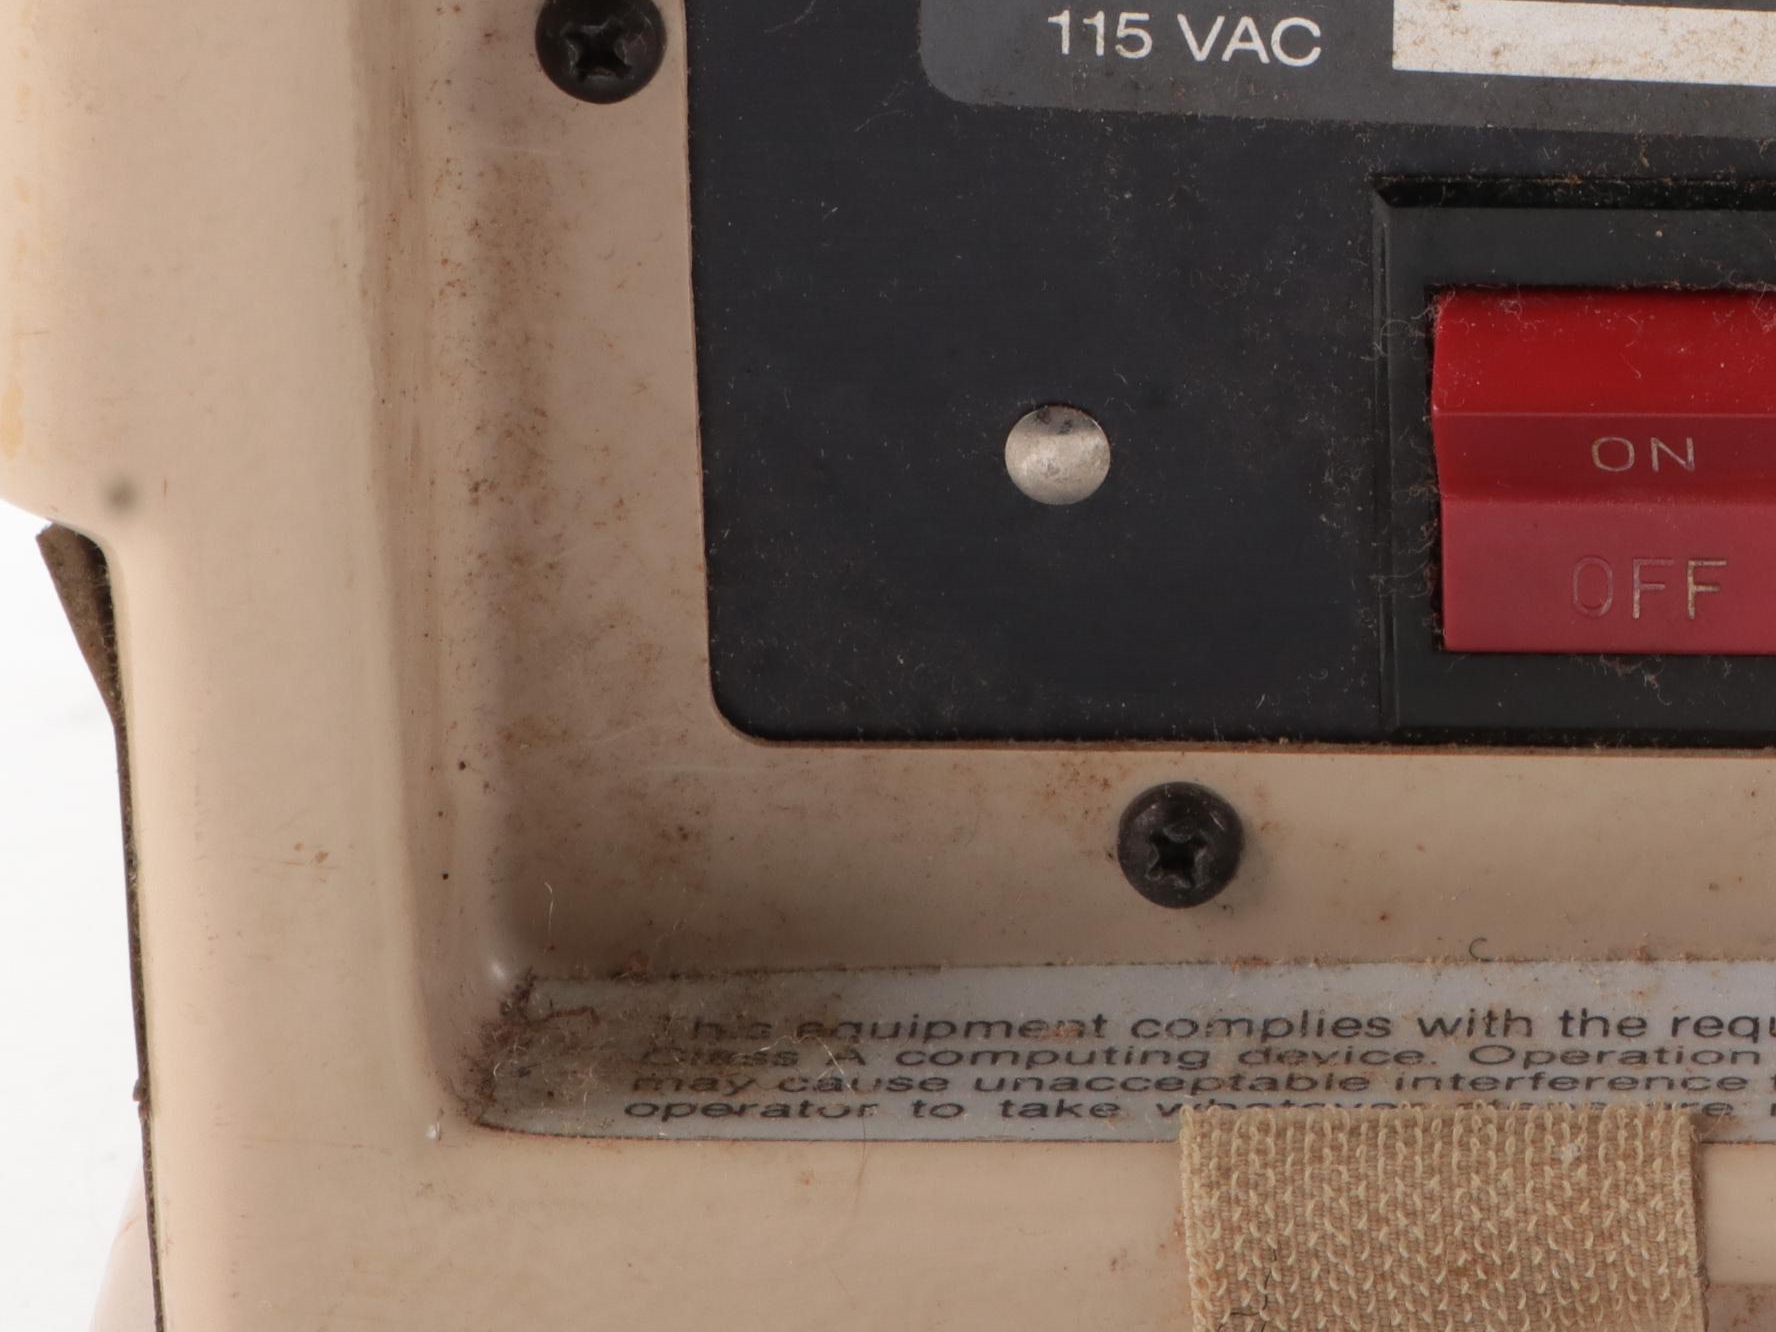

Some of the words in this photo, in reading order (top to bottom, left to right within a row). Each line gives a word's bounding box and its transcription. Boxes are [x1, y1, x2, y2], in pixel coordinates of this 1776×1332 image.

[1047, 8, 1154, 60] 115
[1176, 13, 1324, 68] VAC
[1590, 436, 1698, 473] ON
[1571, 555, 1728, 620] OFF
[796, 1013, 1109, 1045] equipment
[1130, 1009, 1392, 1044] complies
[1417, 1007, 1533, 1039] with
[1559, 1007, 1648, 1039] the
[825, 1048, 867, 1067] A
[894, 1045, 1210, 1070] computing
[1238, 1045, 1436, 1067] device.
[1468, 1044, 1761, 1070] Operation
[631, 1076, 757, 1096] may
[777, 1076, 950, 1093] cause
[973, 1072, 1372, 1096] unacceptable
[1395, 1070, 1749, 1092] interference
[624, 1099, 879, 1122] operator
[911, 1099, 966, 1120] to
[998, 1098, 1122, 1119] take
